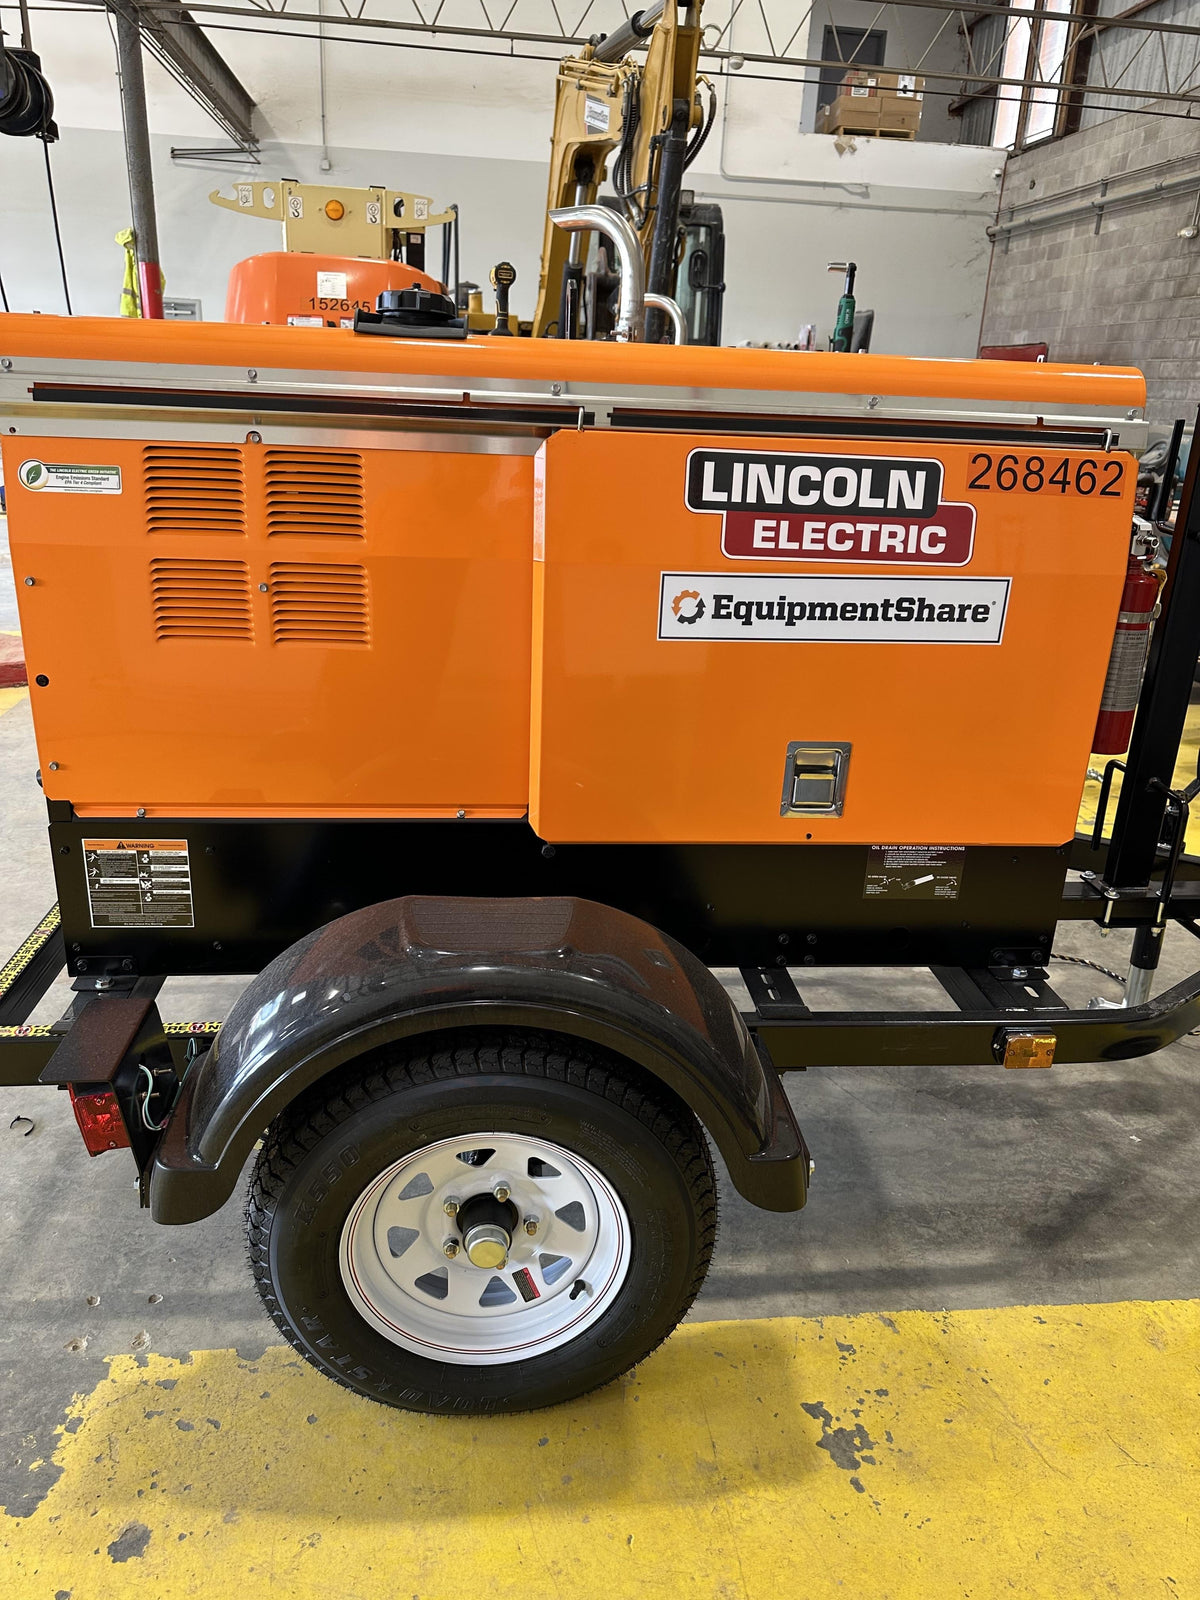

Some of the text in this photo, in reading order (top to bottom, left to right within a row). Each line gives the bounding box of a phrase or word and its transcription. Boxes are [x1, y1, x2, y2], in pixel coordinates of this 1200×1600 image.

[308, 297, 371, 312] 152645
[701, 461, 928, 510] LINCOLN
[968, 453, 1124, 497] 268462
[752, 519, 948, 555] ELECTRIC
